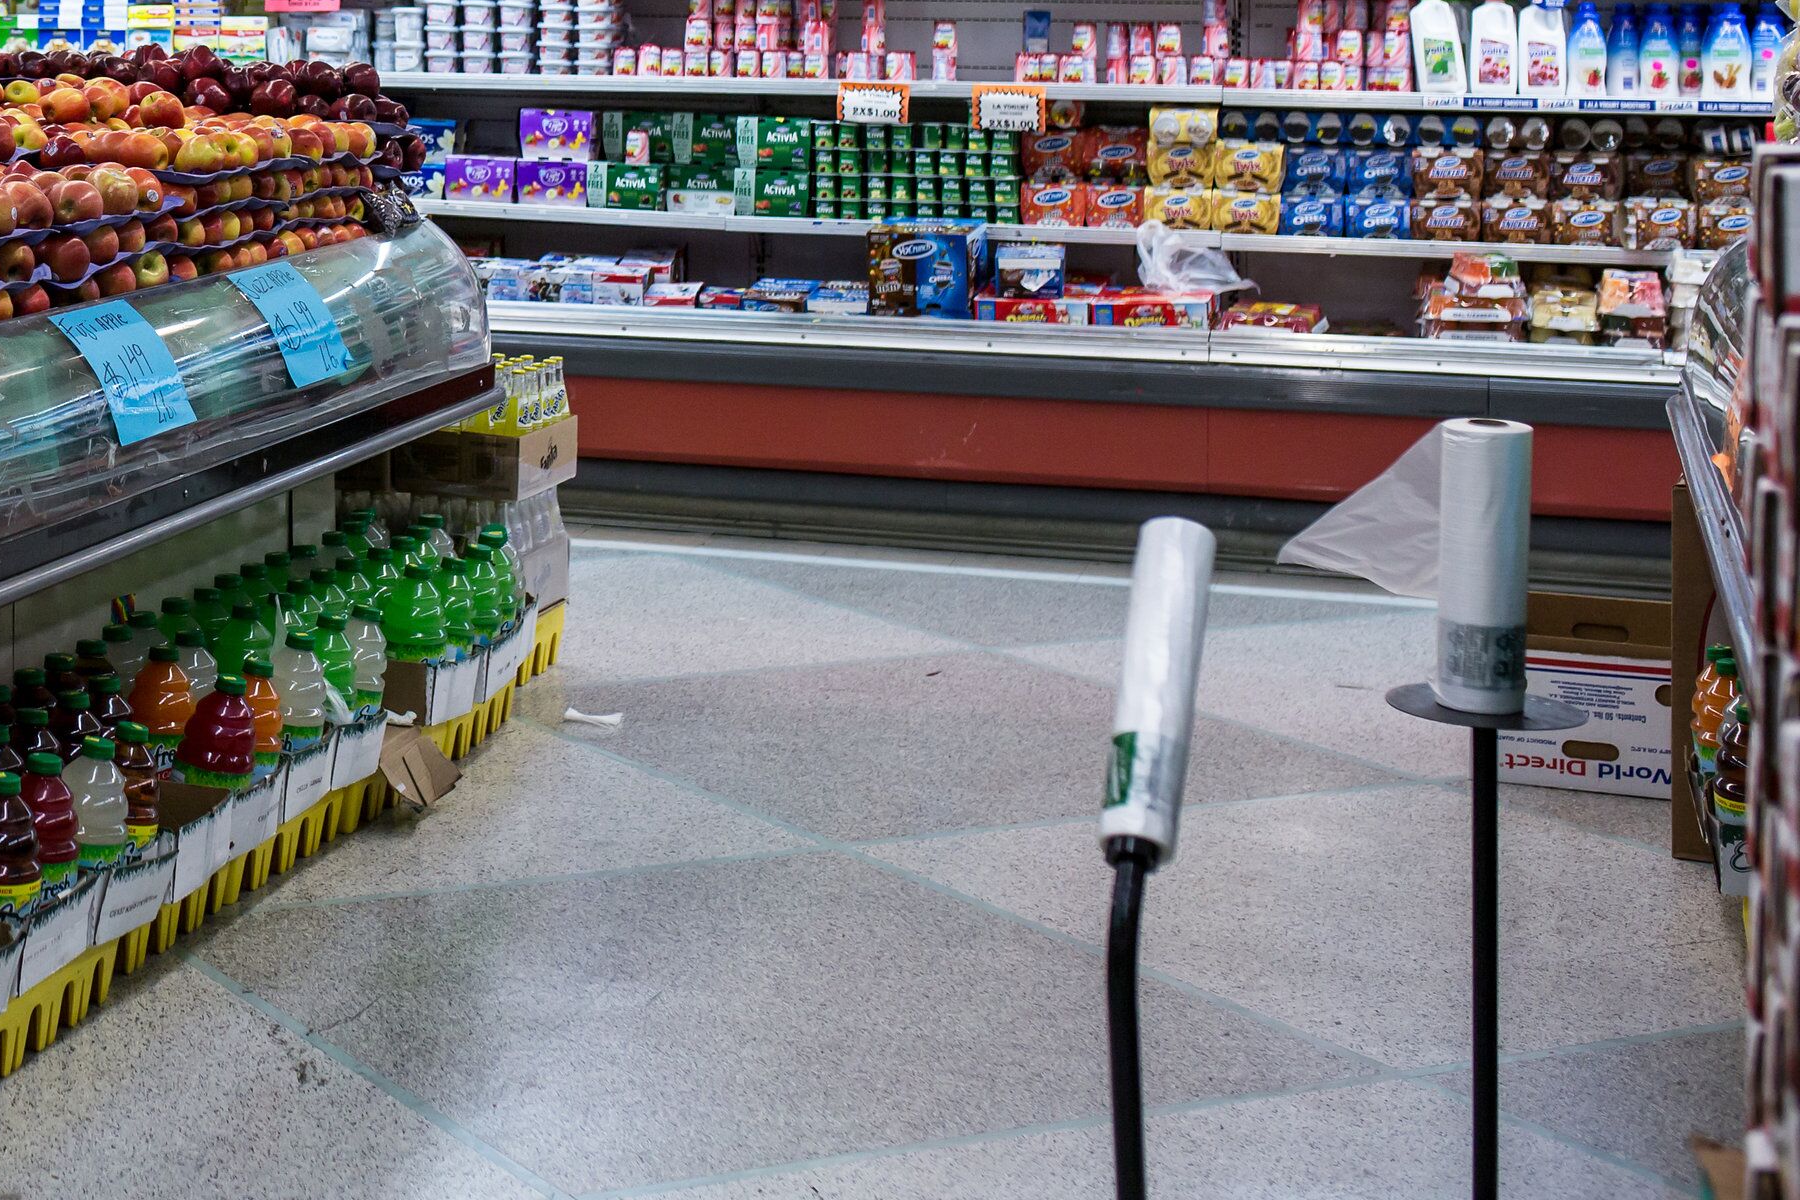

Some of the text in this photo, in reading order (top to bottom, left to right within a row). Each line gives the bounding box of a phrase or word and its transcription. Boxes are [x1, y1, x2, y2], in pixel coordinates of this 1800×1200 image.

[852, 107, 897, 118] 2X$1.00
[988, 119, 1034, 129] 2X$1.00
[701, 127, 732, 139] ACTIVIA
[766, 131, 798, 143] ACTIVIA
[1167, 159, 1196, 171] Twix
[1233, 160, 1261, 172] Twix
[588, 180, 603, 189] FREE
[615, 176, 646, 189] ACTIVIA
[687, 178, 718, 190] ACTIVIA
[735, 187, 751, 196] FREE
[764, 183, 796, 196] ACTIVIA
[1163, 207, 1193, 219] Twix
[1231, 209, 1260, 220] Twix
[897, 241, 934, 257] YoCrunch
[551, 389, 565, 416] Fanta
[1605, 712, 1613, 721] 50
[1527, 737, 1557, 747] PRODUCT
